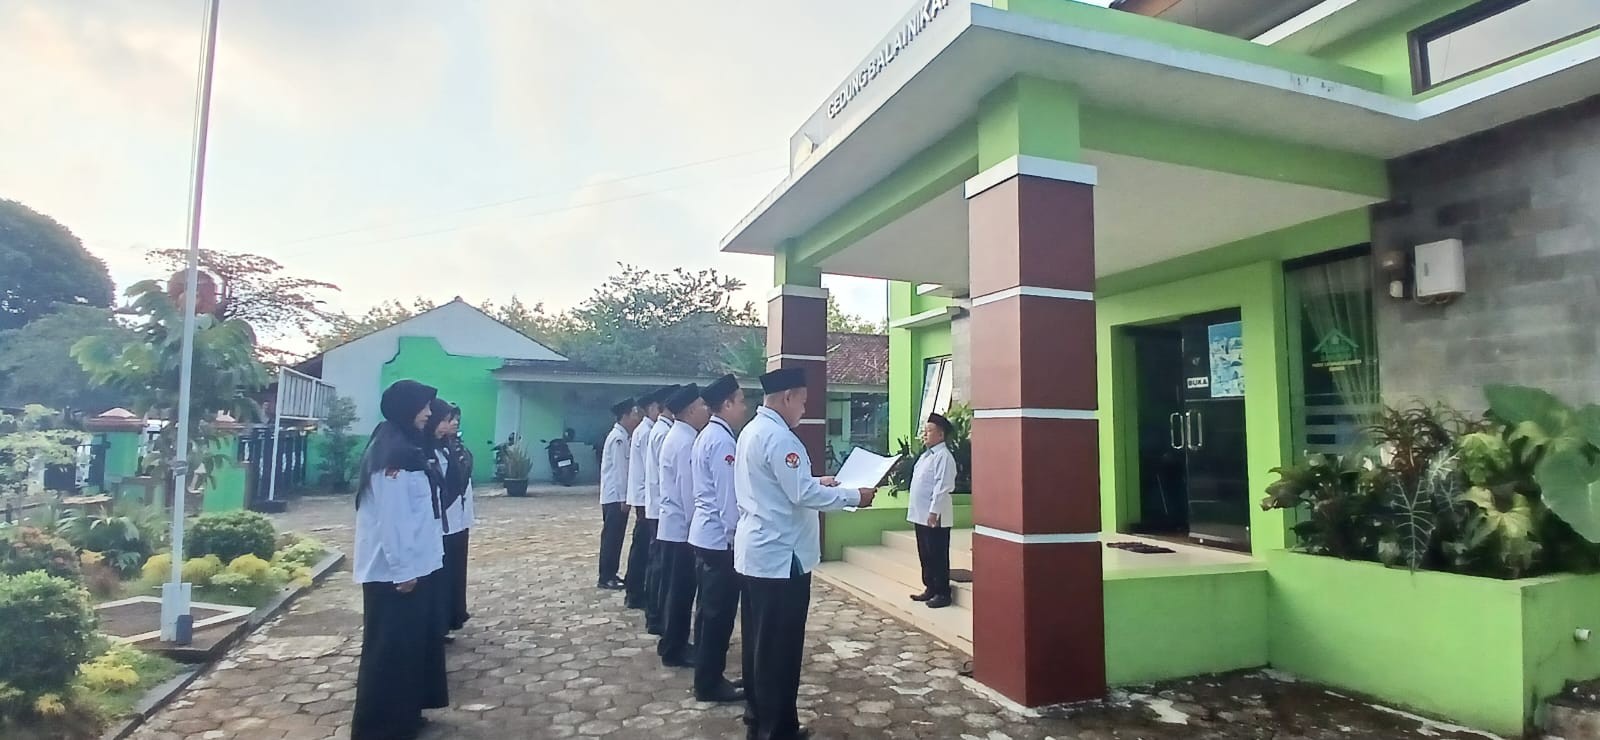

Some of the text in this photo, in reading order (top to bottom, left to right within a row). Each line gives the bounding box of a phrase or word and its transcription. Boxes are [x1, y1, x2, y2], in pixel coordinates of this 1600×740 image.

[828, 0, 949, 119] GEDUNG BALAI NIKA
